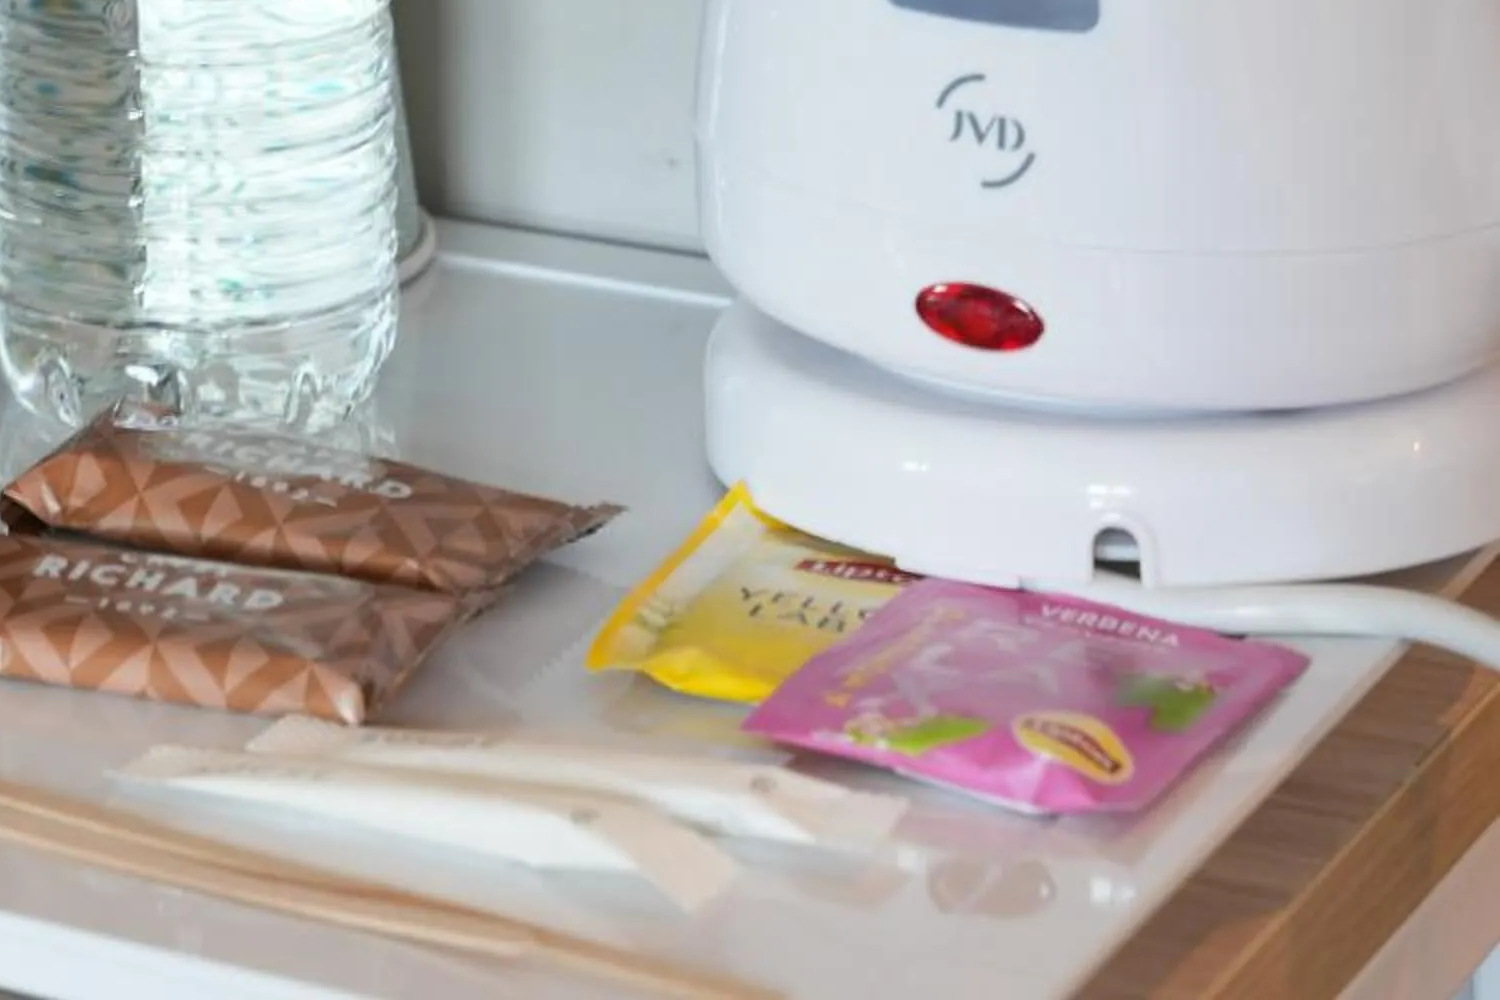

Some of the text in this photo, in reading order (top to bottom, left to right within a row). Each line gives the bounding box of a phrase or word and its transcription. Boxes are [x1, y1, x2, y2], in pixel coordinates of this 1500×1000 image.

[948, 109, 1026, 152] JVD
[33, 553, 284, 611] RICHARD
[1041, 604, 1181, 647] VERBENA
